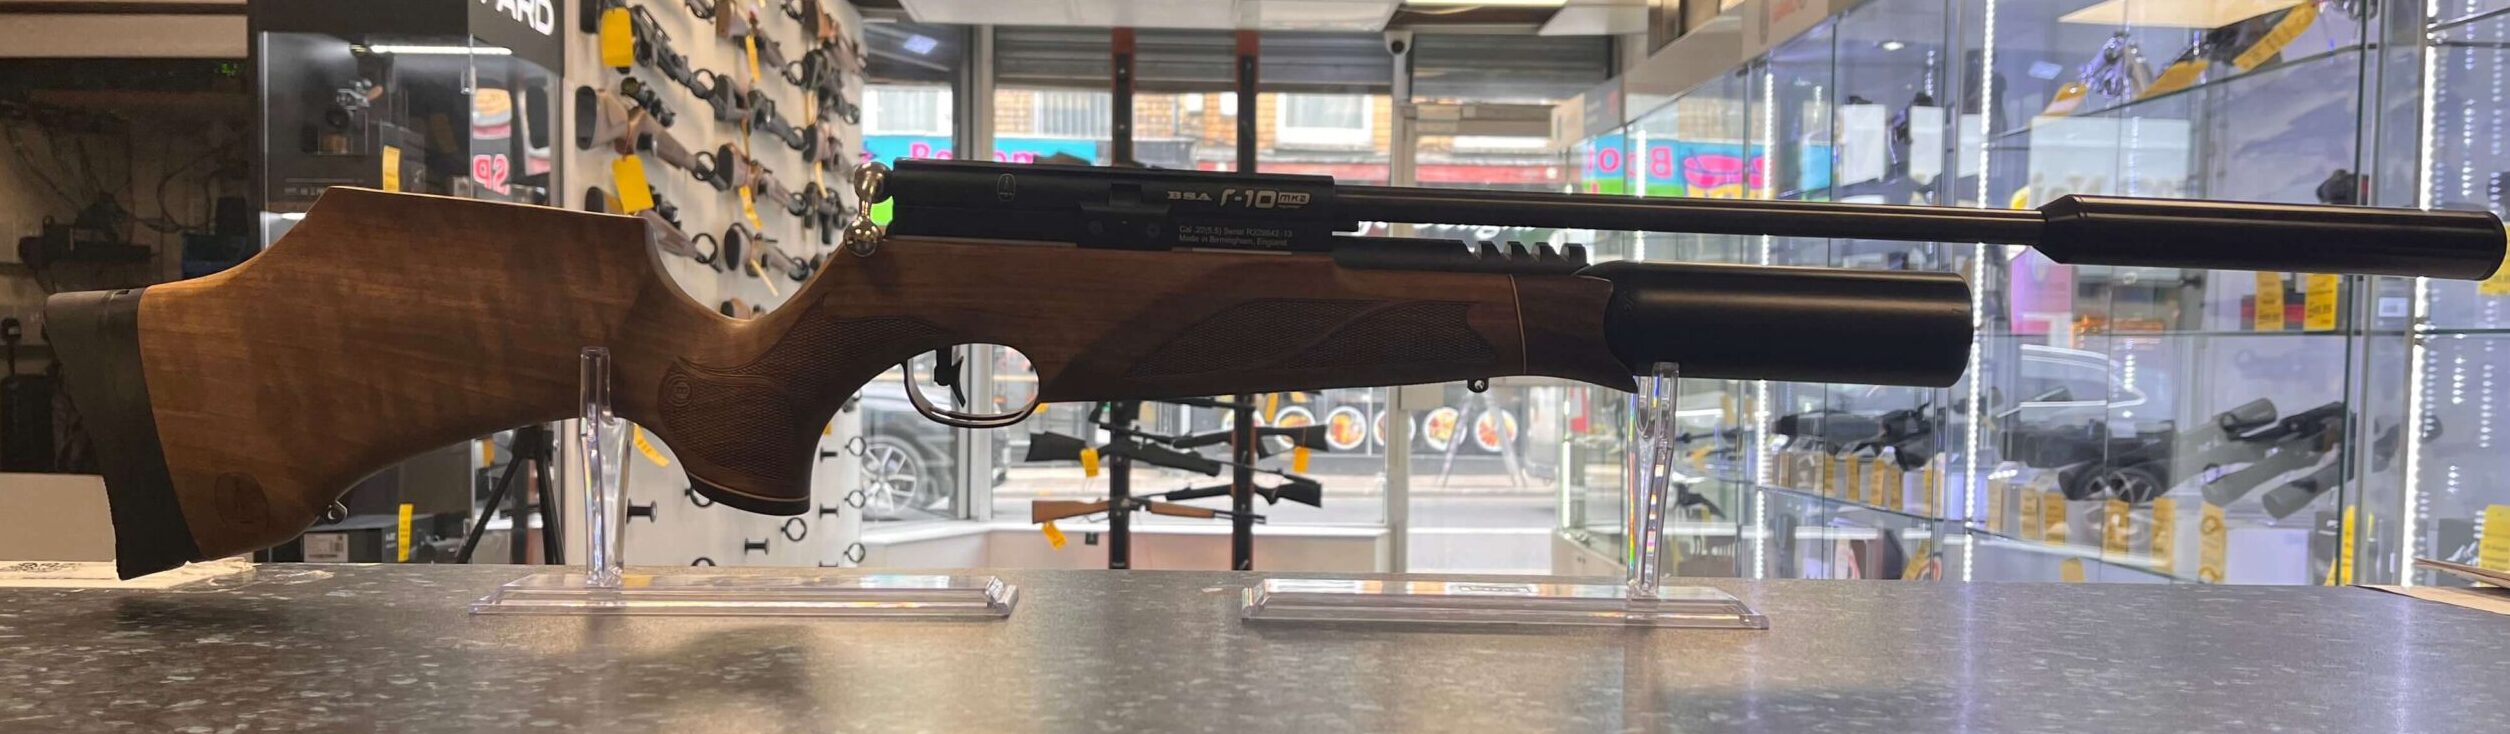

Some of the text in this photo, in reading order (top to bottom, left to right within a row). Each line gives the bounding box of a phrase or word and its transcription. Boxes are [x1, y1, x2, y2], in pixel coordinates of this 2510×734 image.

[1167, 190, 1213, 201] BSA
[1179, 234, 1200, 242] Made
[1256, 238, 1288, 247] England
